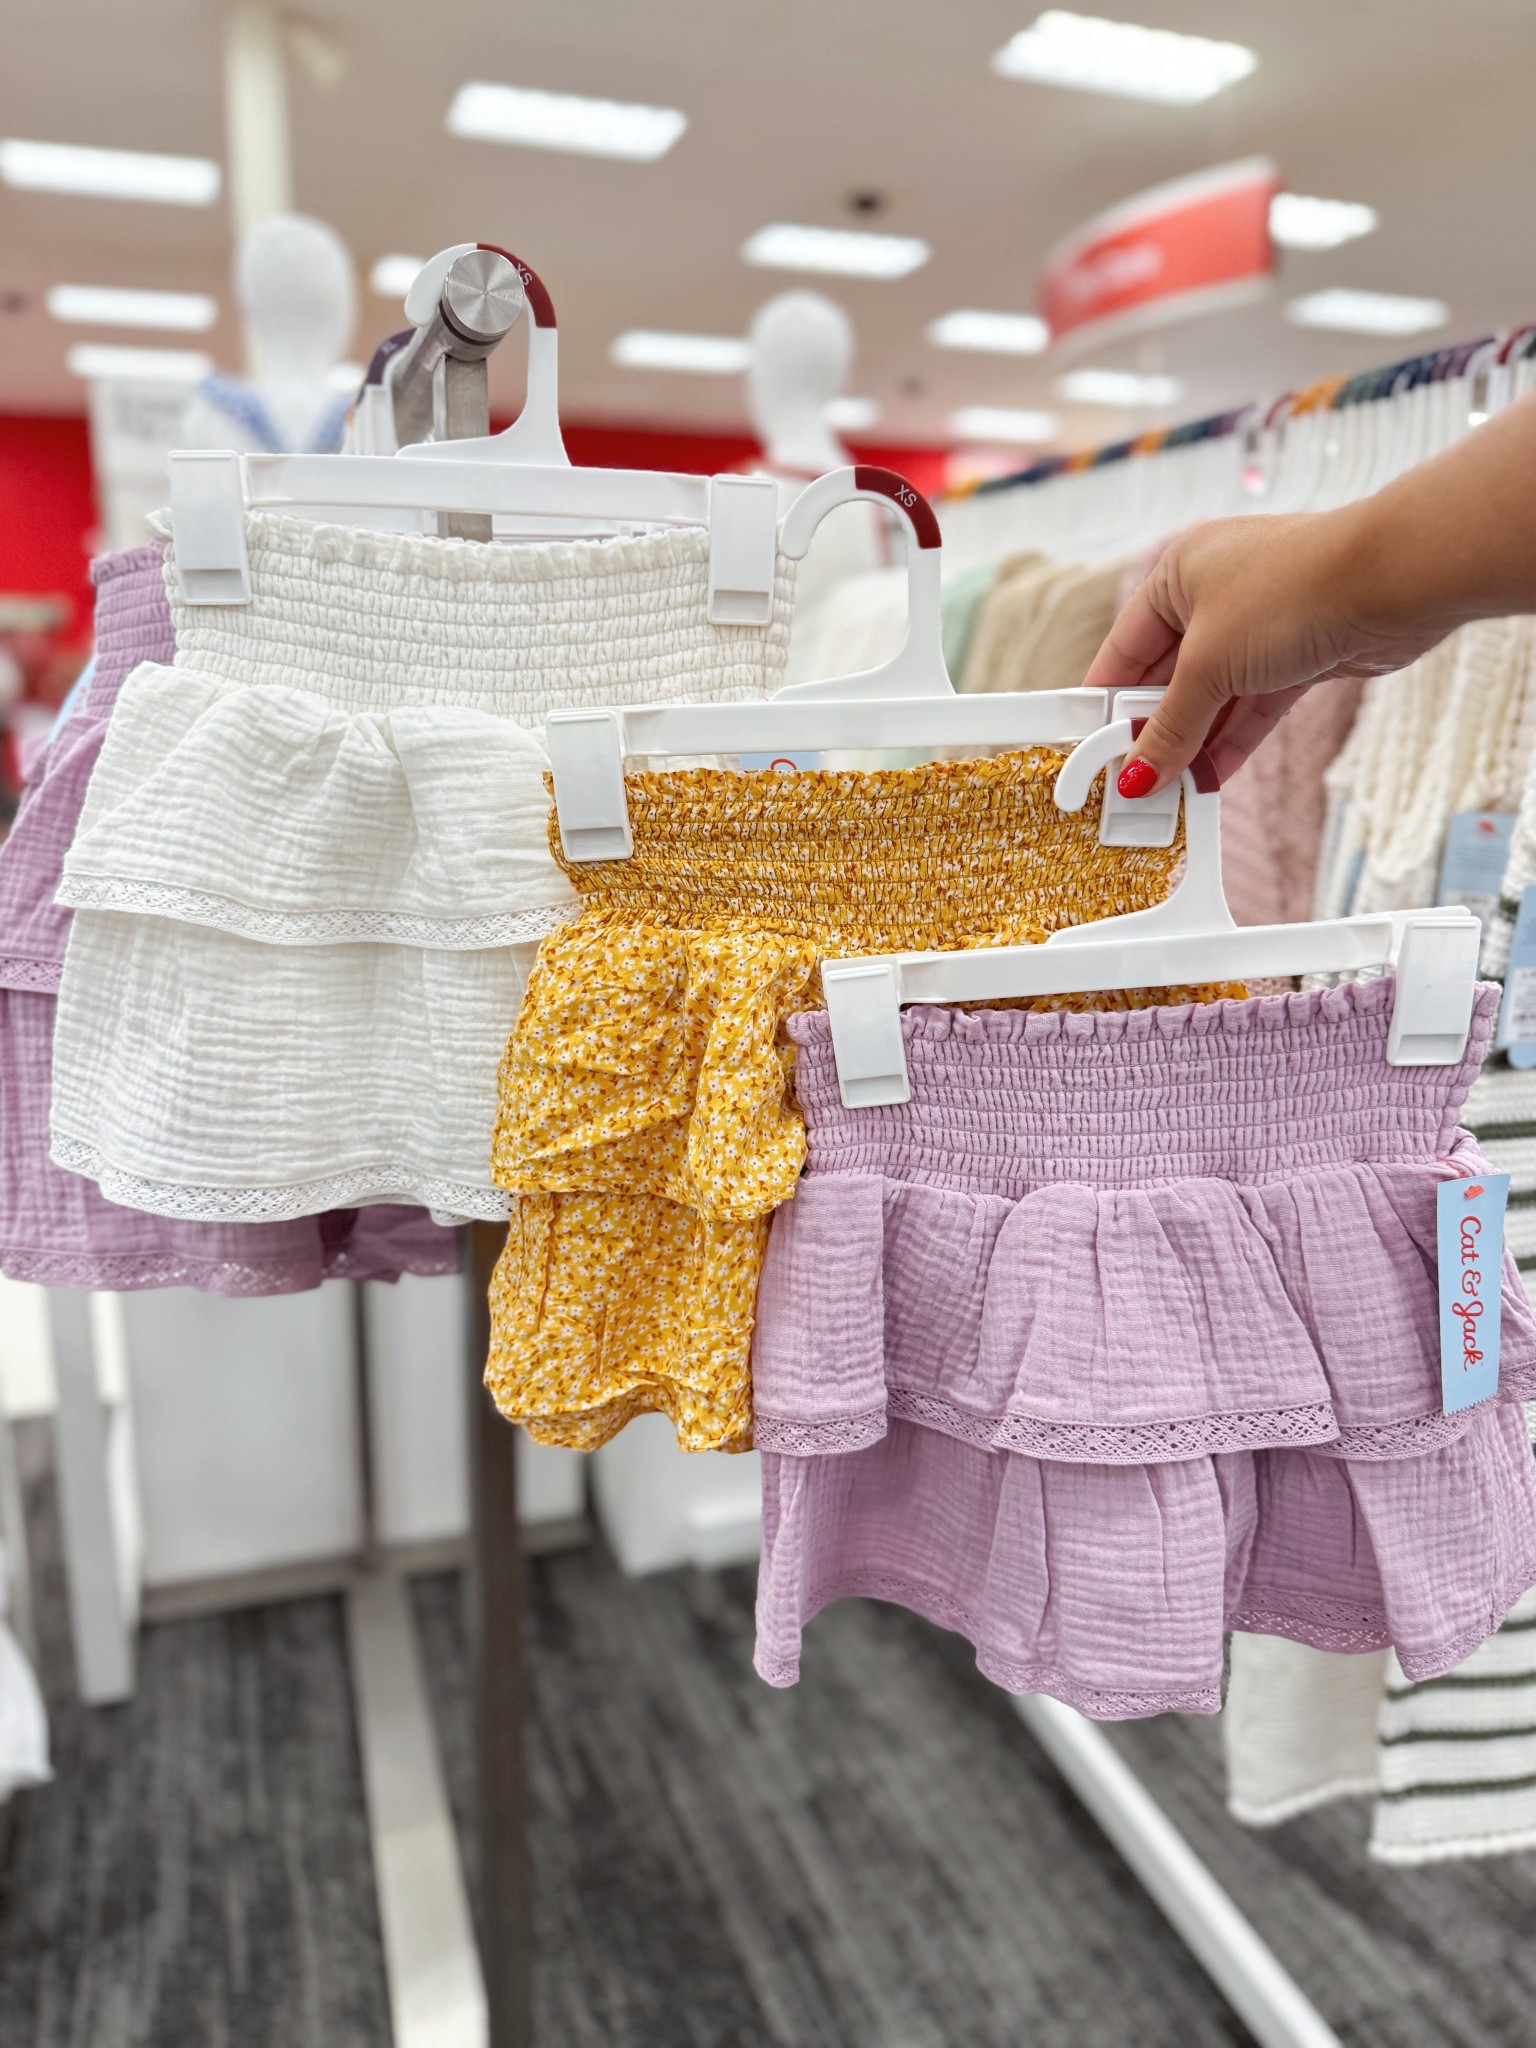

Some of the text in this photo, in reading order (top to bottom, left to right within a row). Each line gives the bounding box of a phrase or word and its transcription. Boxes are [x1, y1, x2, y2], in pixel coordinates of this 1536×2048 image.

[894, 484, 917, 508] XS
[1452, 1215, 1484, 1371] Cat & Jack
